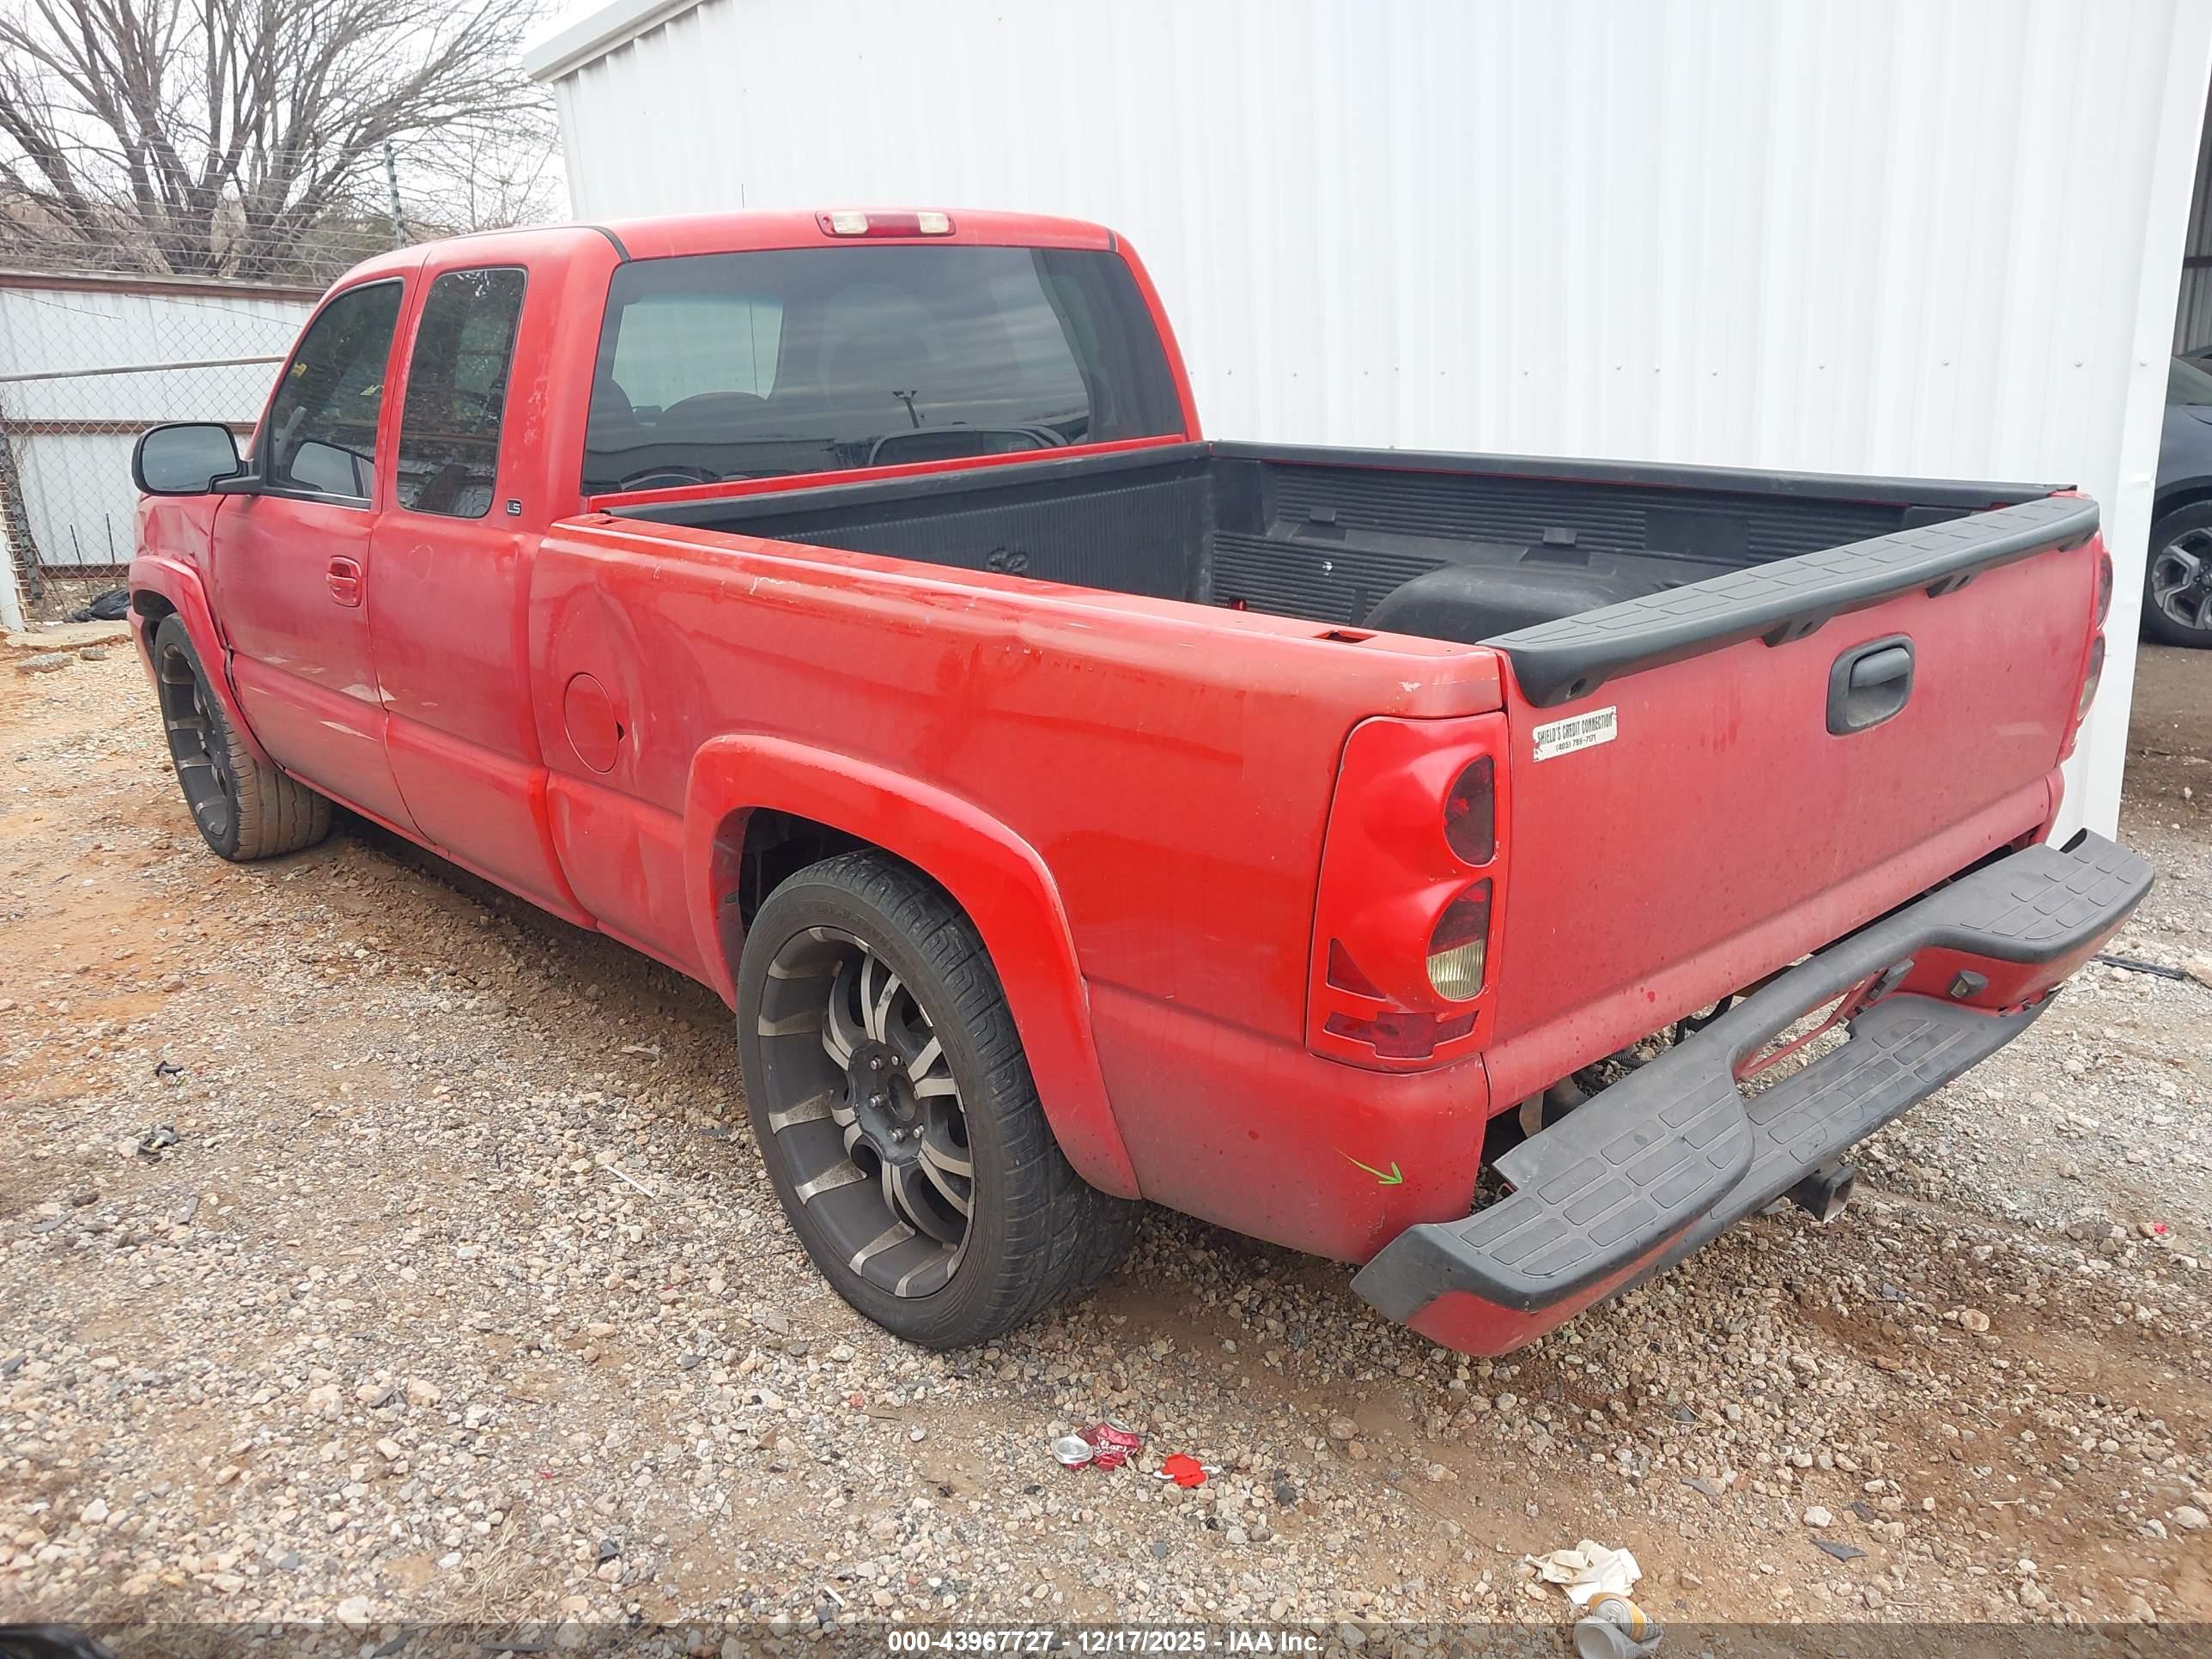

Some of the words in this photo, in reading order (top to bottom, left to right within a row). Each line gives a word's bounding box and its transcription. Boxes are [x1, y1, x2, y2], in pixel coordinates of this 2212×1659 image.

[507, 502, 520, 514] LS
[1537, 726, 1561, 745] SHIELD'S
[1562, 721, 1581, 739] CREDIT
[1581, 714, 1613, 735] CONNECTION
[1555, 740, 1571, 751] (405)
